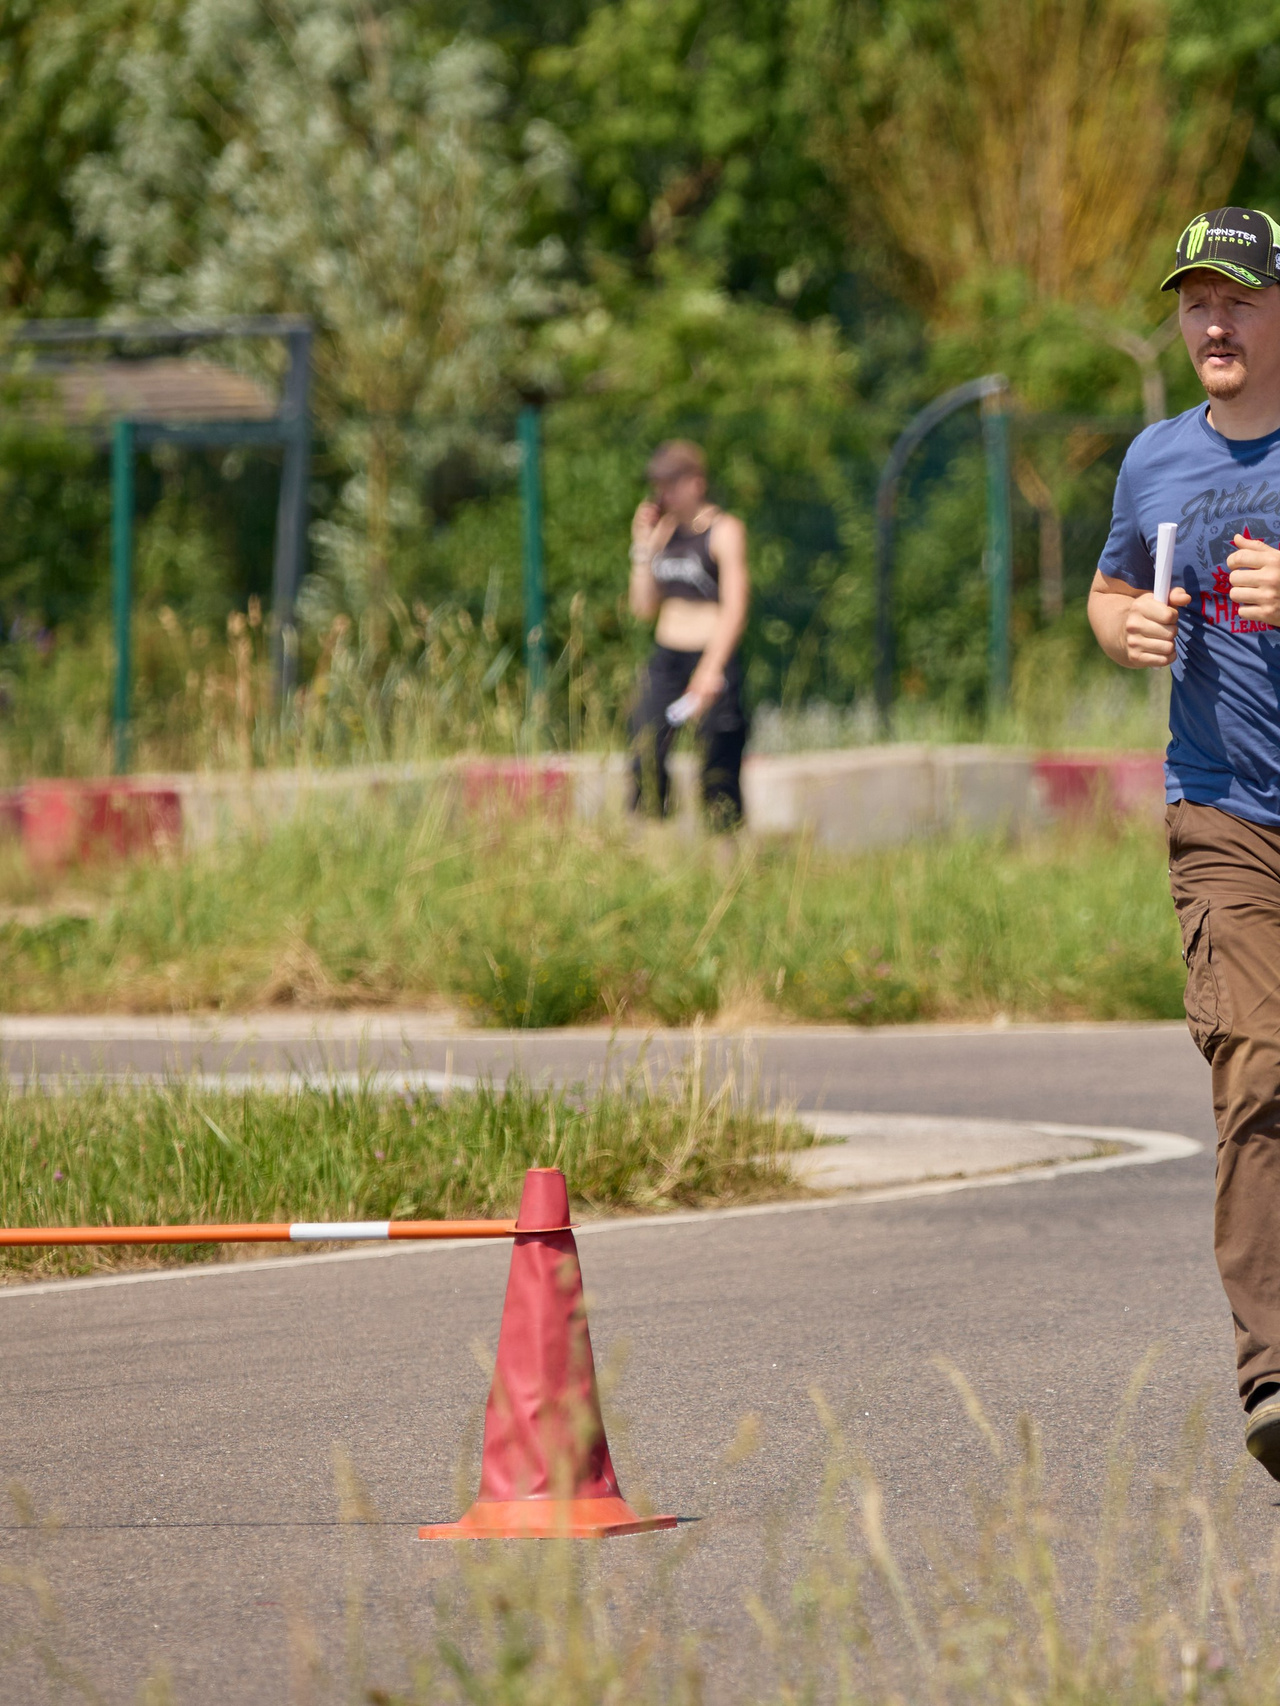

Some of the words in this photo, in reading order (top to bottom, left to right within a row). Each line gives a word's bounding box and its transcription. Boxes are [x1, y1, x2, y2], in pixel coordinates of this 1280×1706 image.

[1206, 228, 1257, 243] MONSTER
[1208, 236, 1251, 246] ENERGY
[1200, 591, 1241, 626] CHA
